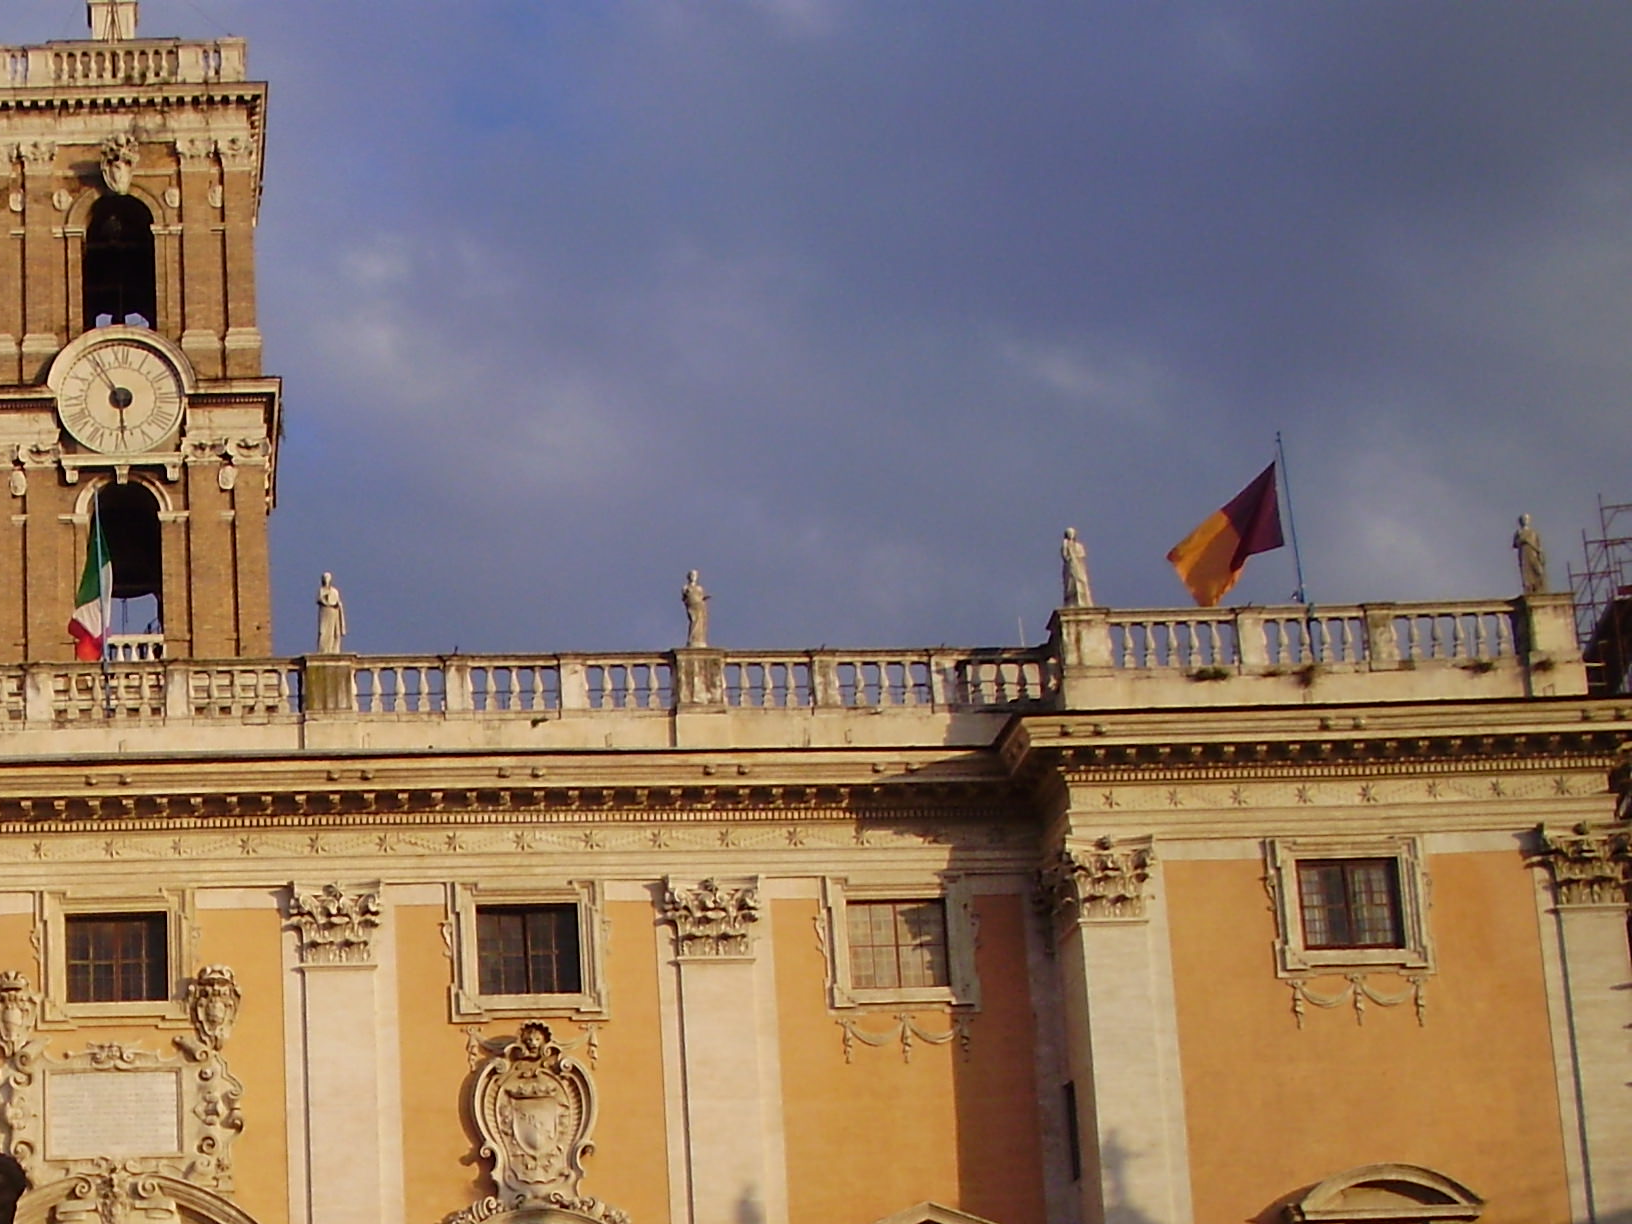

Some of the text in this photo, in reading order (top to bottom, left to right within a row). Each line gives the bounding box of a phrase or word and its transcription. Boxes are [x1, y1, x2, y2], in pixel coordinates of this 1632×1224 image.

[112, 347, 130, 367] XII
[153, 369, 170, 383] II
[156, 391, 179, 404] III
